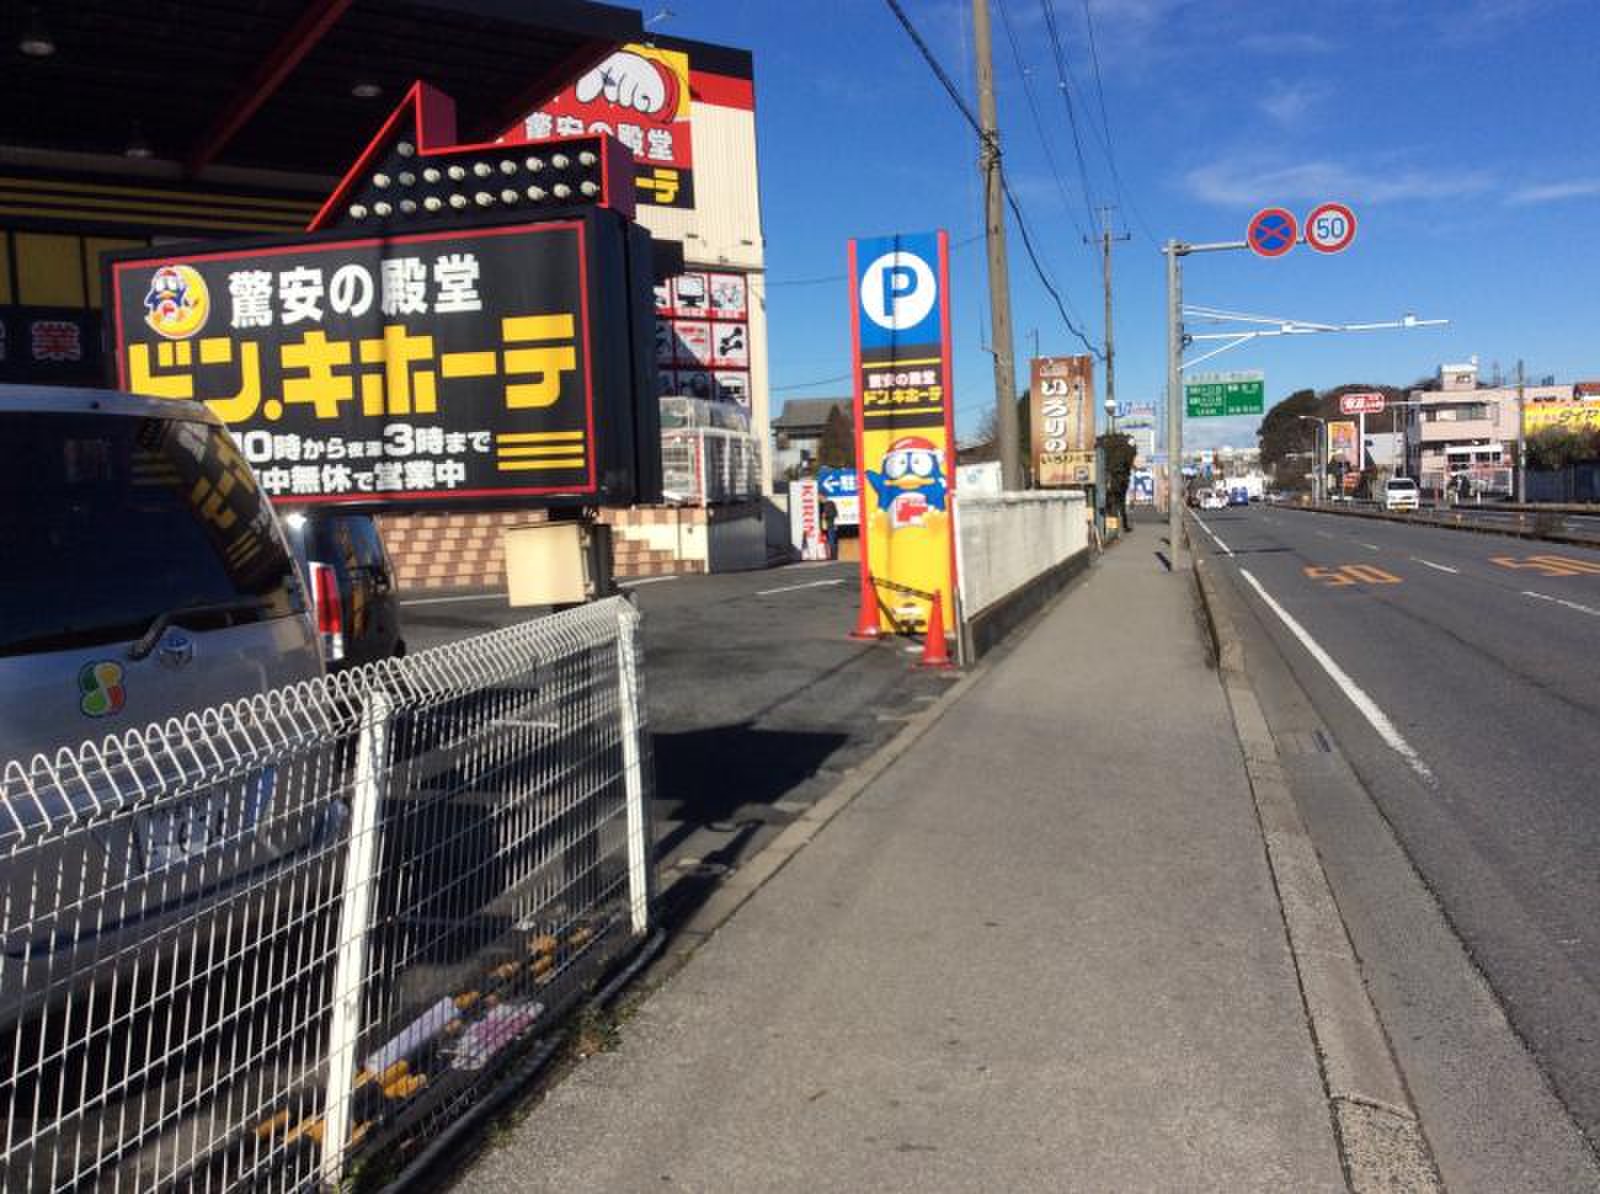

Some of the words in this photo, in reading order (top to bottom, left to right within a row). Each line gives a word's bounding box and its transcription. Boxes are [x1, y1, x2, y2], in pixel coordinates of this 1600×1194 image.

[1316, 217, 1345, 239] 50
[228, 254, 483, 329] 驚安の殿堂
[881, 265, 918, 317] P
[253, 459, 466, 495] 中無休で営業中
